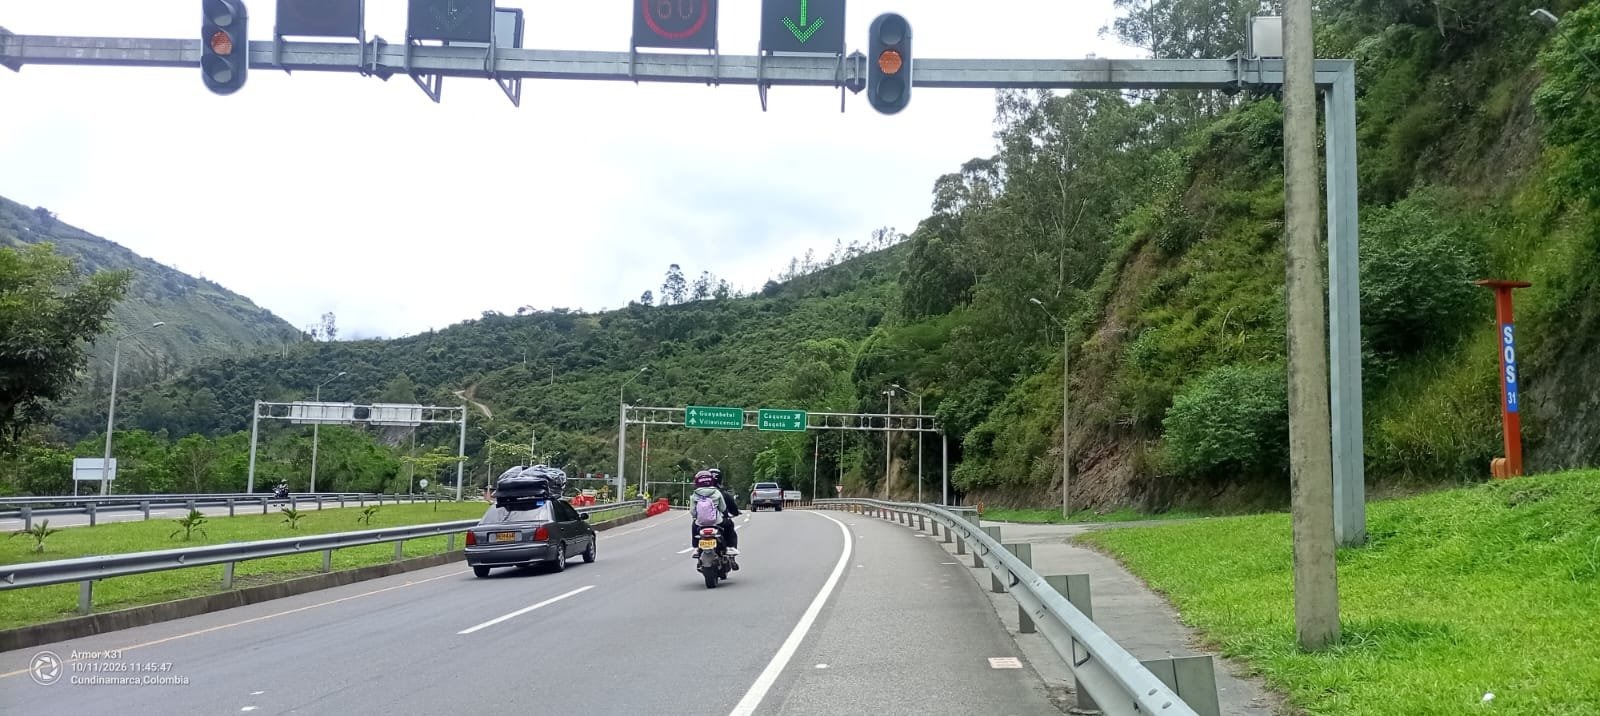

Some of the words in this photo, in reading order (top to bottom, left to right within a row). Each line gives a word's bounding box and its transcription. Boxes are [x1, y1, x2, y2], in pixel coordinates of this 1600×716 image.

[1504, 326, 1516, 383] SOS
[1507, 391, 1516, 405] 31
[699, 410, 735, 418] Guayabetal
